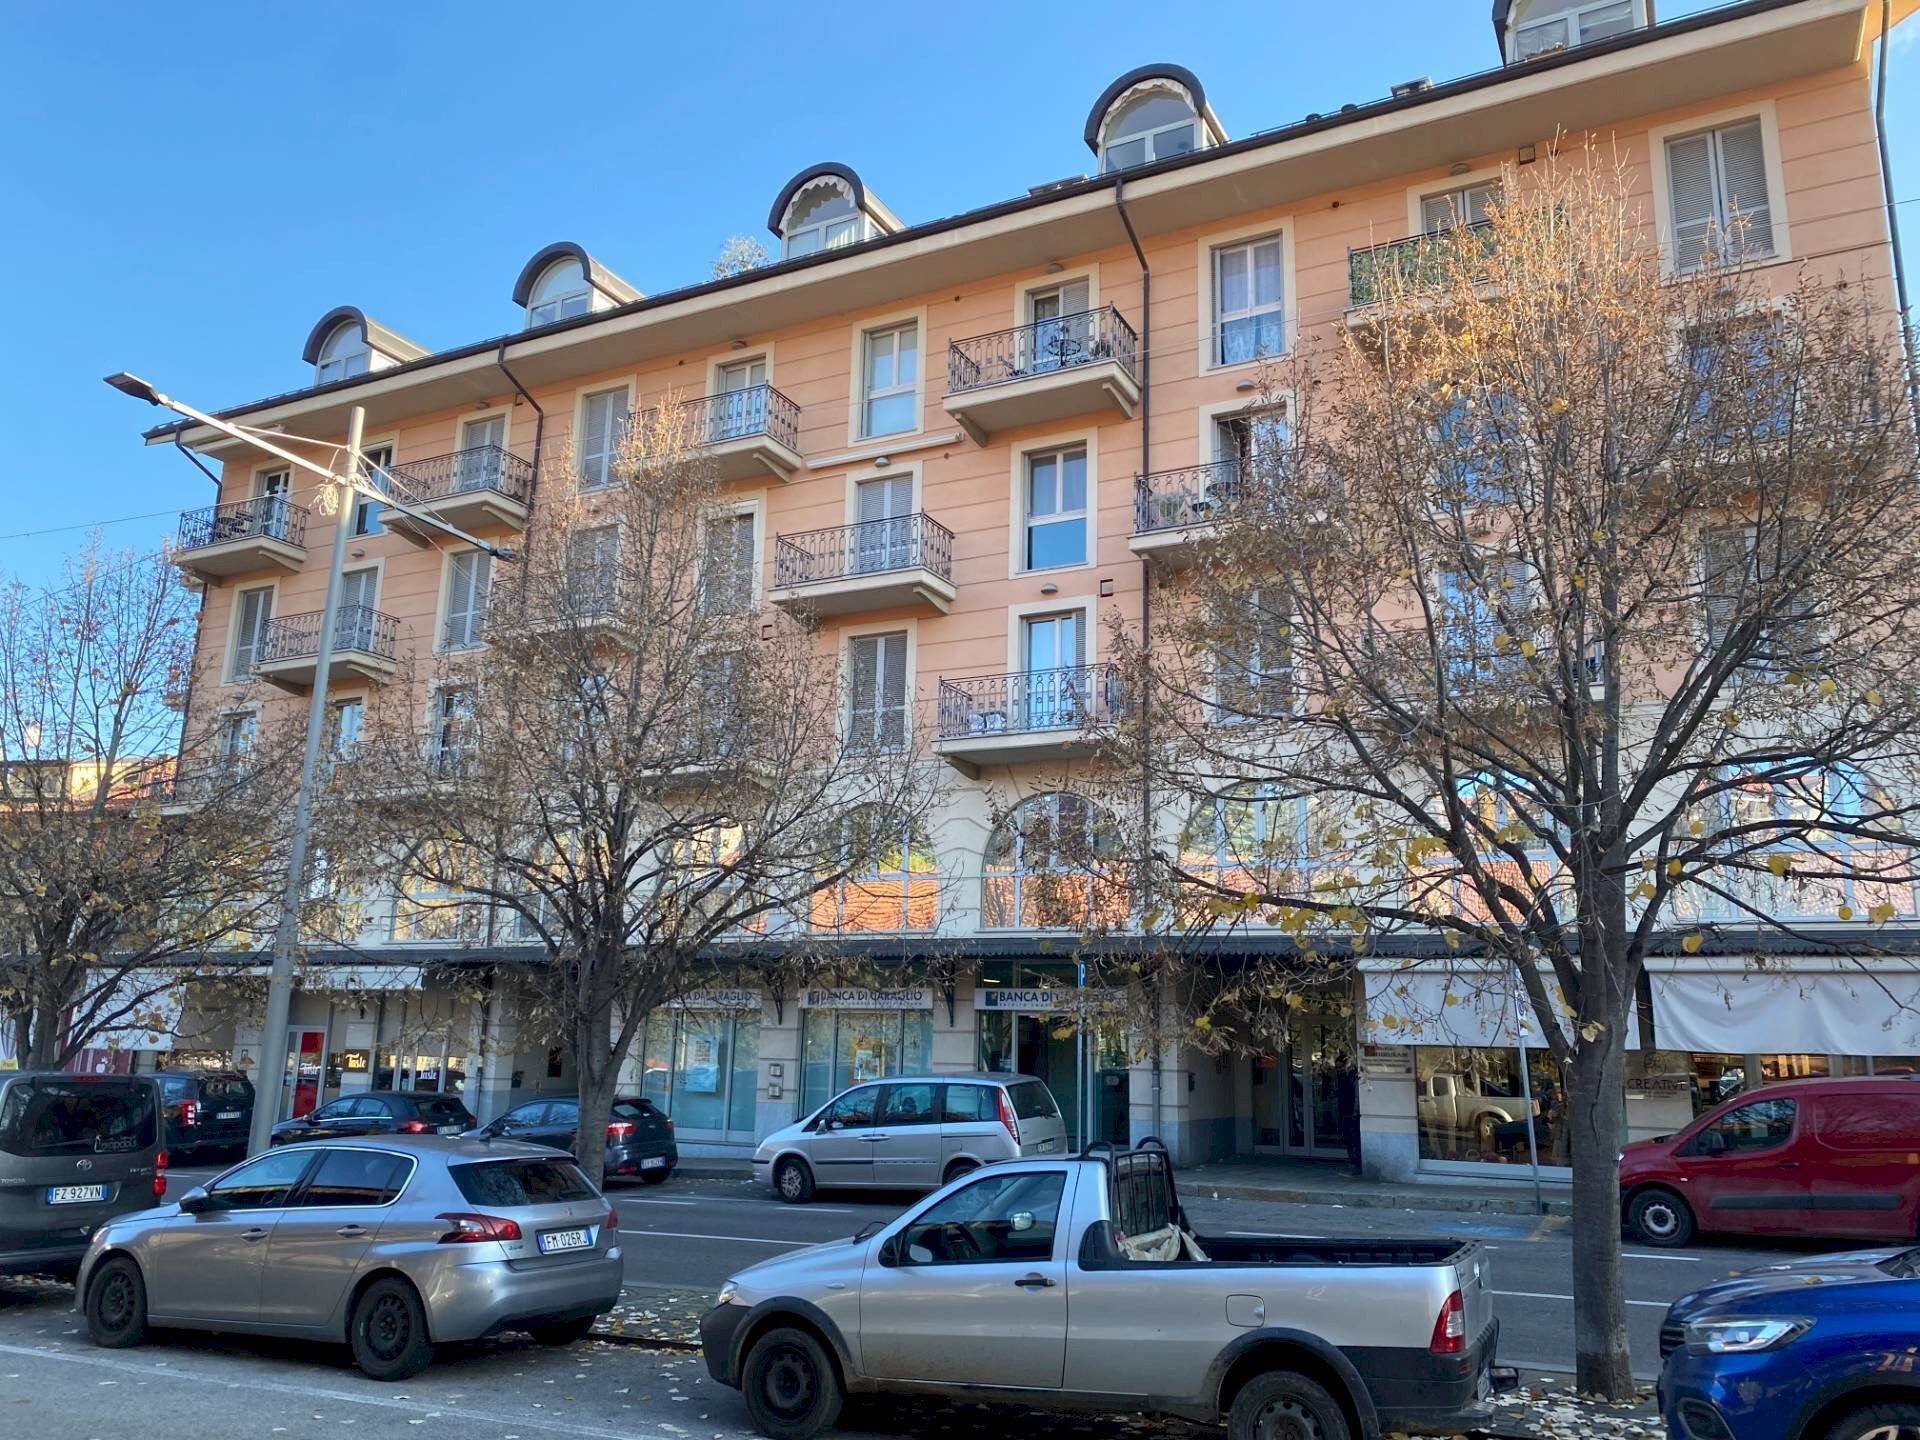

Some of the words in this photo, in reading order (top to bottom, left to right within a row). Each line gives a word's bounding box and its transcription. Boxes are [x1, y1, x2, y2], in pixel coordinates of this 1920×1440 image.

[1080, 963, 1086, 986] P
[857, 990, 868, 1001] DI
[1000, 991, 1039, 1002] BANCA
[1041, 991, 1053, 1002] DI
[54, 1187, 67, 1200] FZ
[71, 1185, 101, 1199] 927VN
